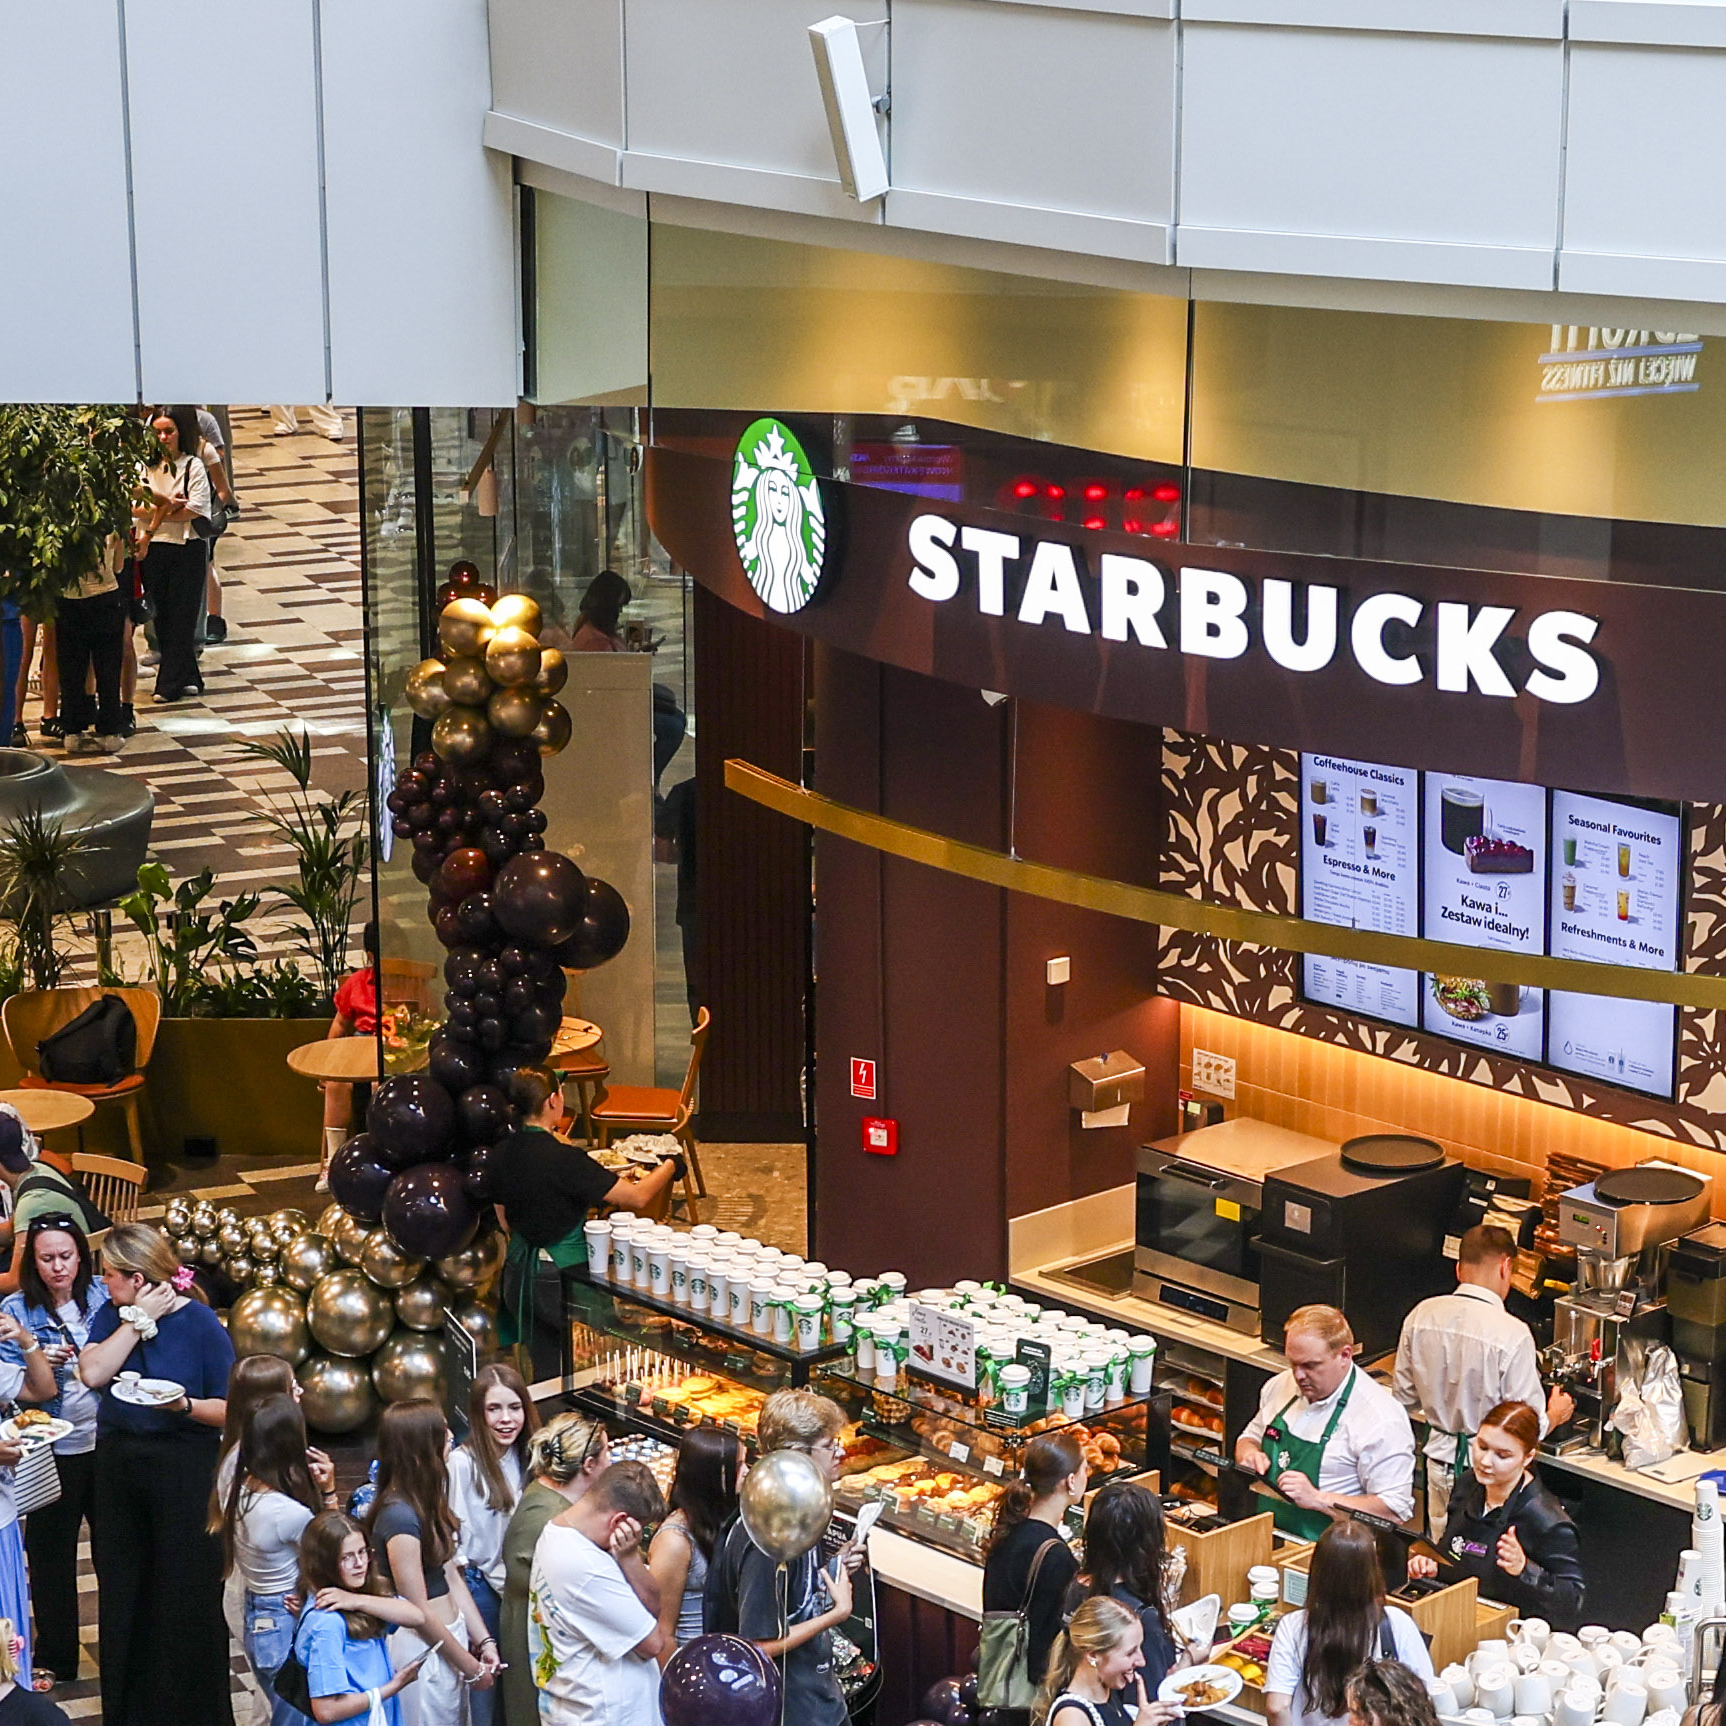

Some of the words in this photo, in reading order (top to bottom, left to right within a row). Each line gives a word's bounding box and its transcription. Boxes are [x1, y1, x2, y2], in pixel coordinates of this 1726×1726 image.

[908, 514, 1599, 704] STARBUCKS
[1314, 756, 1368, 778] Coffeehouse
[1370, 769, 1405, 786] Classics
[1569, 814, 1610, 834] Seasonal
[1613, 825, 1662, 845] Favourites
[1323, 854, 1361, 873] Espresso
[1362, 865, 1370, 874] &
[1372, 867, 1396, 881] More
[1461, 894, 1492, 914] Kawa
[1441, 905, 1482, 928] Zestaw
[1484, 916, 1530, 941] idealny!
[1561, 922, 1627, 947] Refreshments
[1629, 939, 1636, 949] &
[1639, 942, 1665, 957] More
